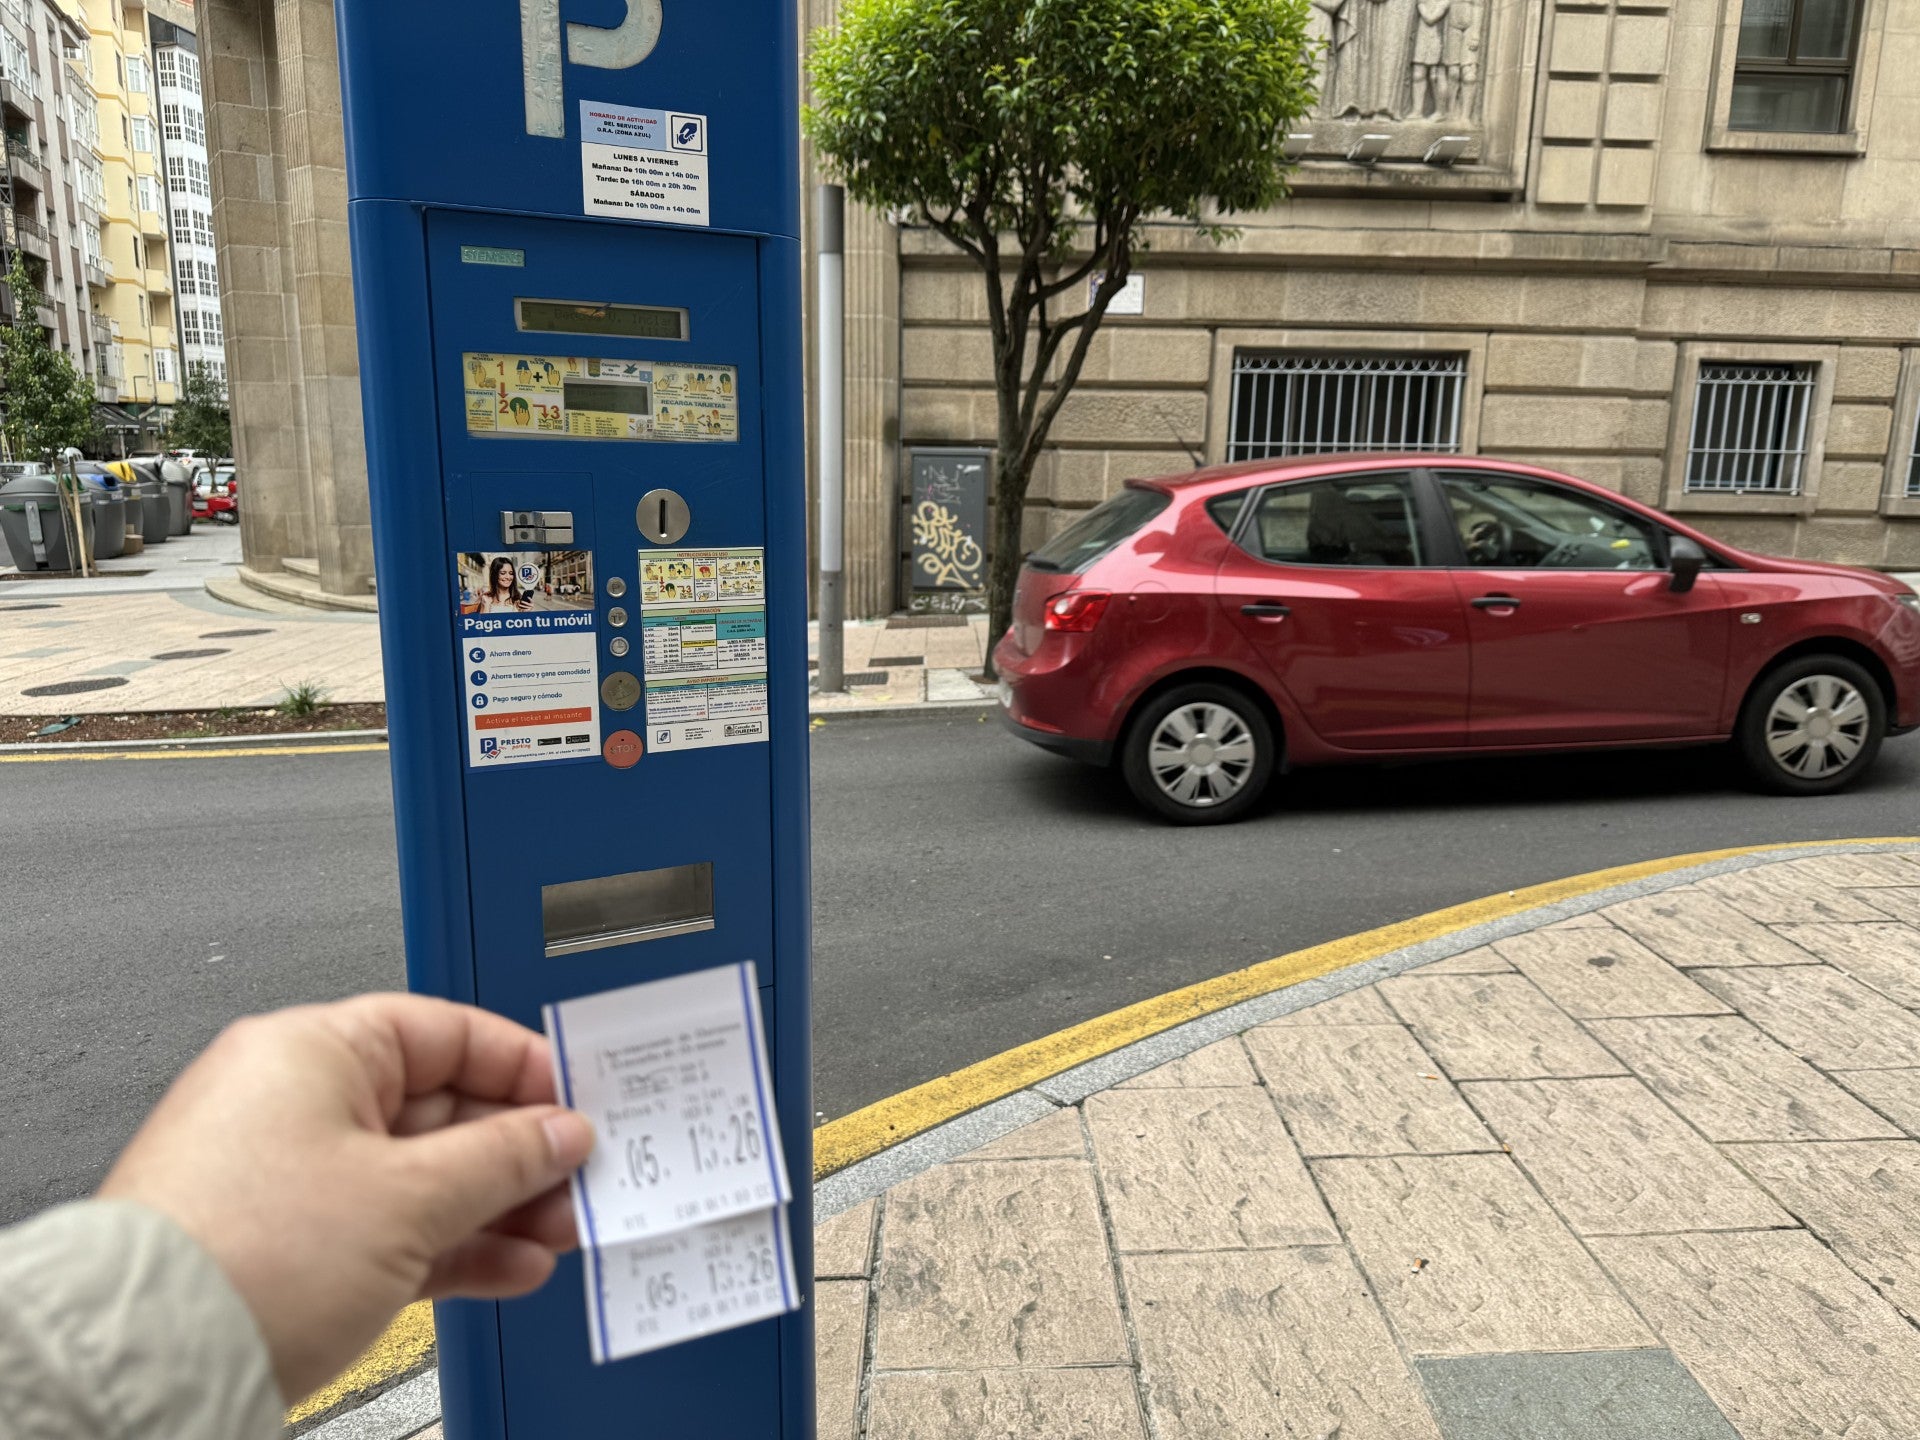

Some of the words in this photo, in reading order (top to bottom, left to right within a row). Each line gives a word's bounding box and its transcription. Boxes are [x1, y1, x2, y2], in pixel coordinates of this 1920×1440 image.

[590, 112, 616, 120] HORARIO
[626, 116, 657, 124] ACTIVIDAD
[617, 122, 644, 130] SERVICIO
[634, 131, 651, 139] AZUL)
[614, 153, 638, 161] LUNES
[648, 158, 679, 166] VIERNES
[592, 163, 621, 171] Mañana:
[596, 175, 618, 183] Tarde:
[630, 190, 665, 199] SÁBADOS
[594, 198, 623, 207] Mañana:
[497, 361, 504, 375] 1
[716, 386, 721, 395] 3
[499, 400, 509, 414] 2
[550, 405, 560, 419] 3
[523, 568, 530, 576] P
[464, 618, 502, 632] Paga
[506, 618, 532, 628] con
[536, 617, 550, 627] tu
[554, 613, 592, 626] móvil
[514, 672, 535, 680] tiempo
[511, 694, 531, 702] seguro
[484, 741, 494, 751] P
[610, 744, 637, 754] STOP
